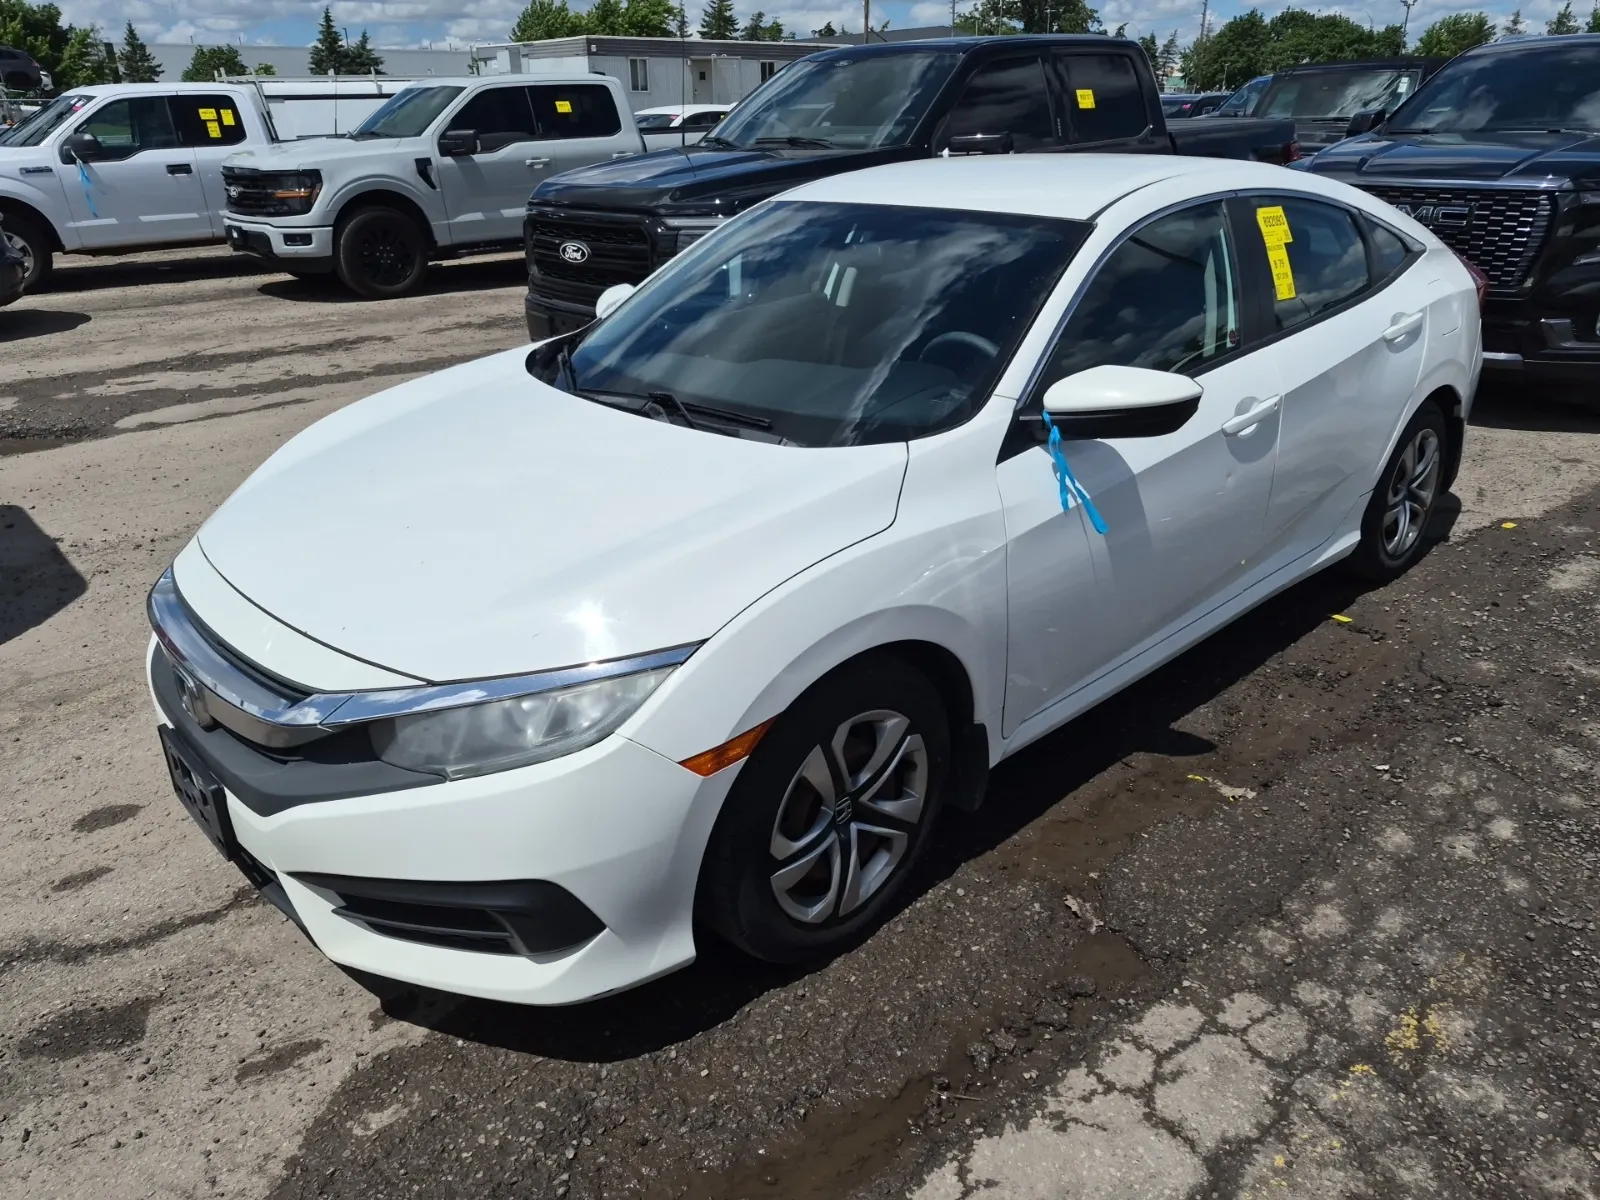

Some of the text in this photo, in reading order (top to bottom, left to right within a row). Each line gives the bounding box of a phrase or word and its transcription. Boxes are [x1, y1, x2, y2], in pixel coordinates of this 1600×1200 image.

[1262, 215, 1285, 227] 892093
[1391, 204, 1470, 226] MC
[564, 245, 582, 260] Ford
